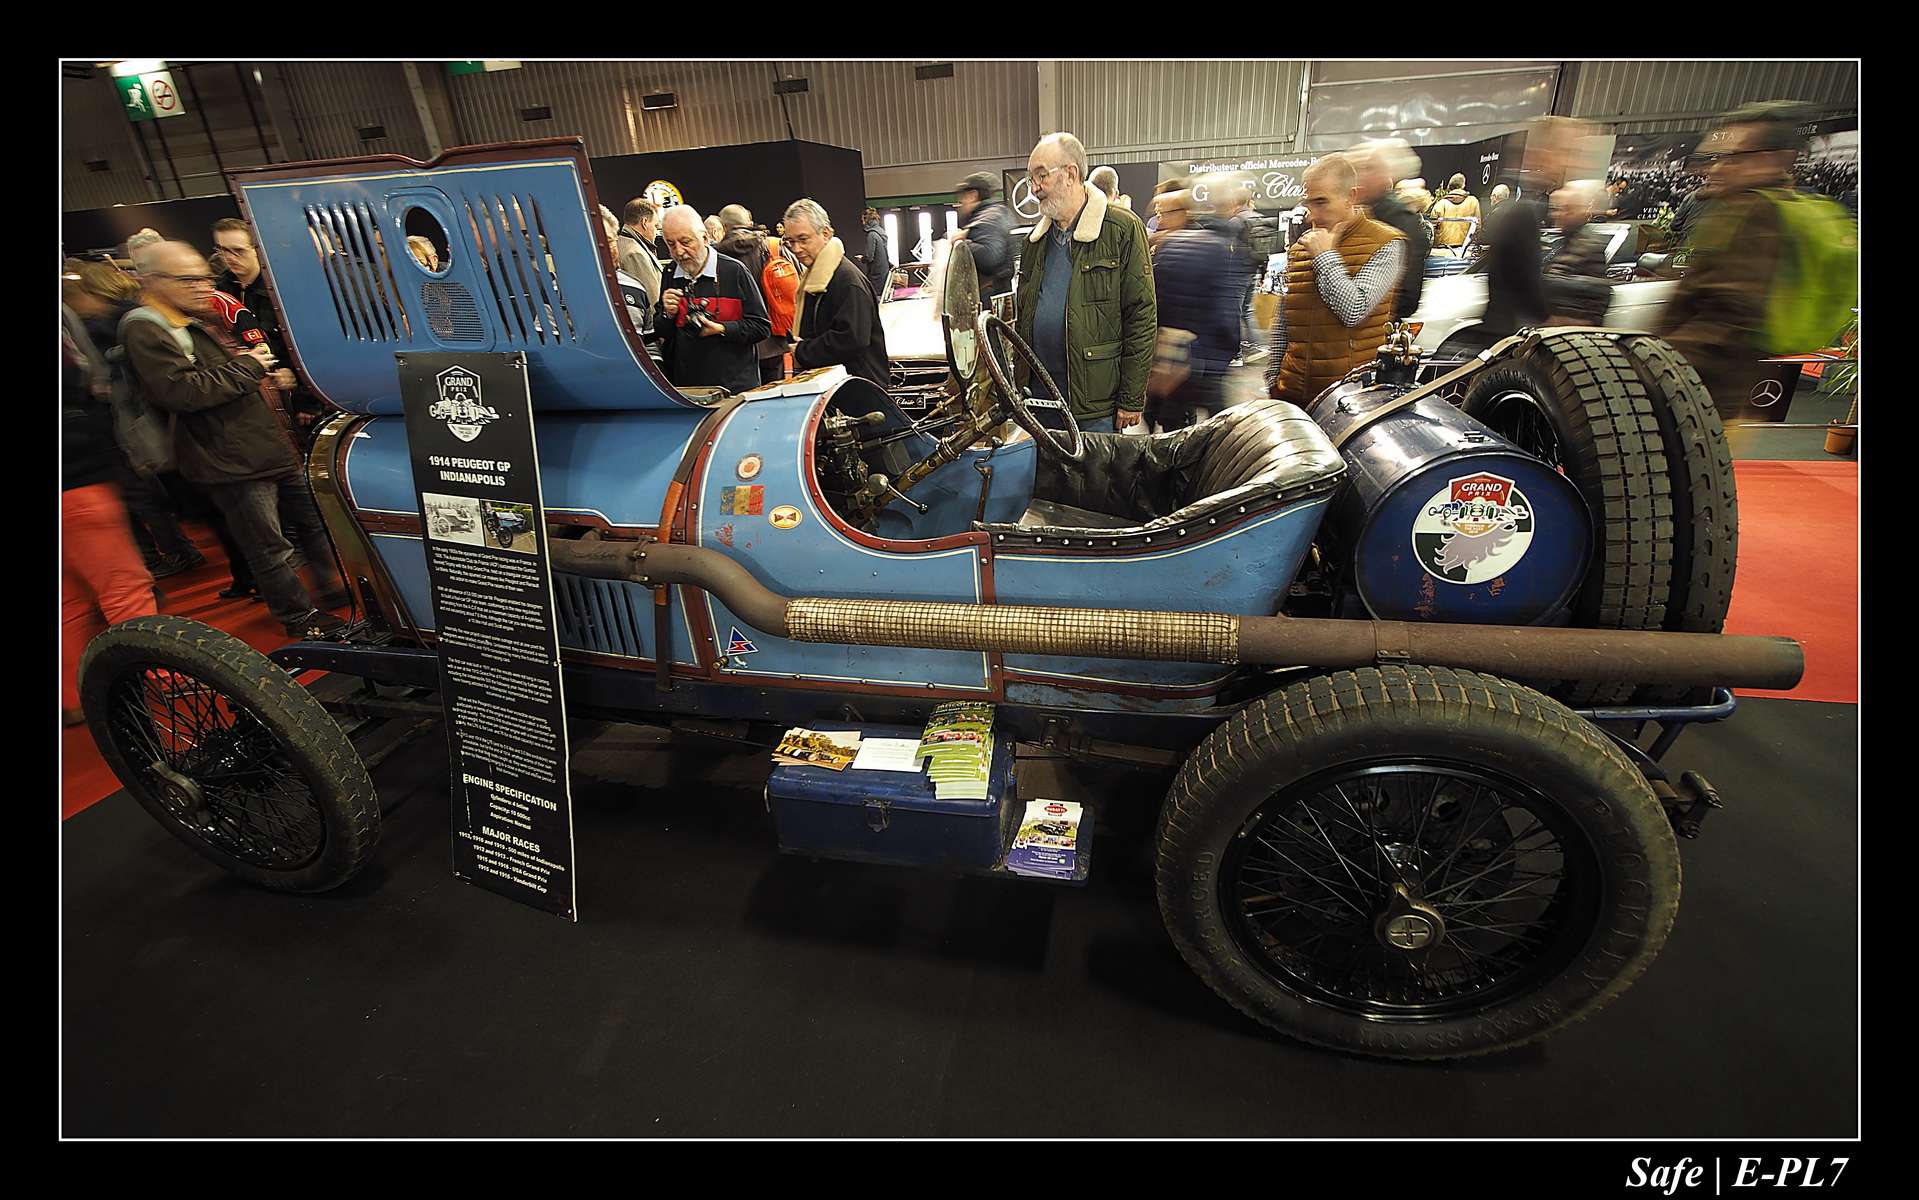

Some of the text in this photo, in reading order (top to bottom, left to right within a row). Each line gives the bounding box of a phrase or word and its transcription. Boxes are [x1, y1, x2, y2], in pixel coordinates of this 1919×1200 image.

[1189, 157, 1324, 174] Distributeur officiel Mercedes-Be
[444, 376, 474, 386] GRAND
[429, 456, 511, 472] 1914 PEUGEOT GP
[440, 471, 506, 486] INDIANAPOLIS
[1461, 482, 1502, 492] GRAND
[463, 773, 557, 811] ENGINE SPECIFICATION
[514, 820, 531, 830] Normal
[482, 826, 541, 853] MAJOR RACES
[484, 838, 493, 846] and
[517, 850, 529, 858] miles
[536, 856, 565, 871] Indianapolis
[510, 856, 525, 866] French
[526, 862, 540, 871] Grand
[540, 867, 550, 875] Prix
[490, 867, 498, 875] and
[513, 876, 537, 890] Vanderbilt
[537, 884, 547, 893] Cup
[512, 866, 522, 874] USA
[522, 870, 537, 879] Grand
[537, 875, 547, 883] Prix
